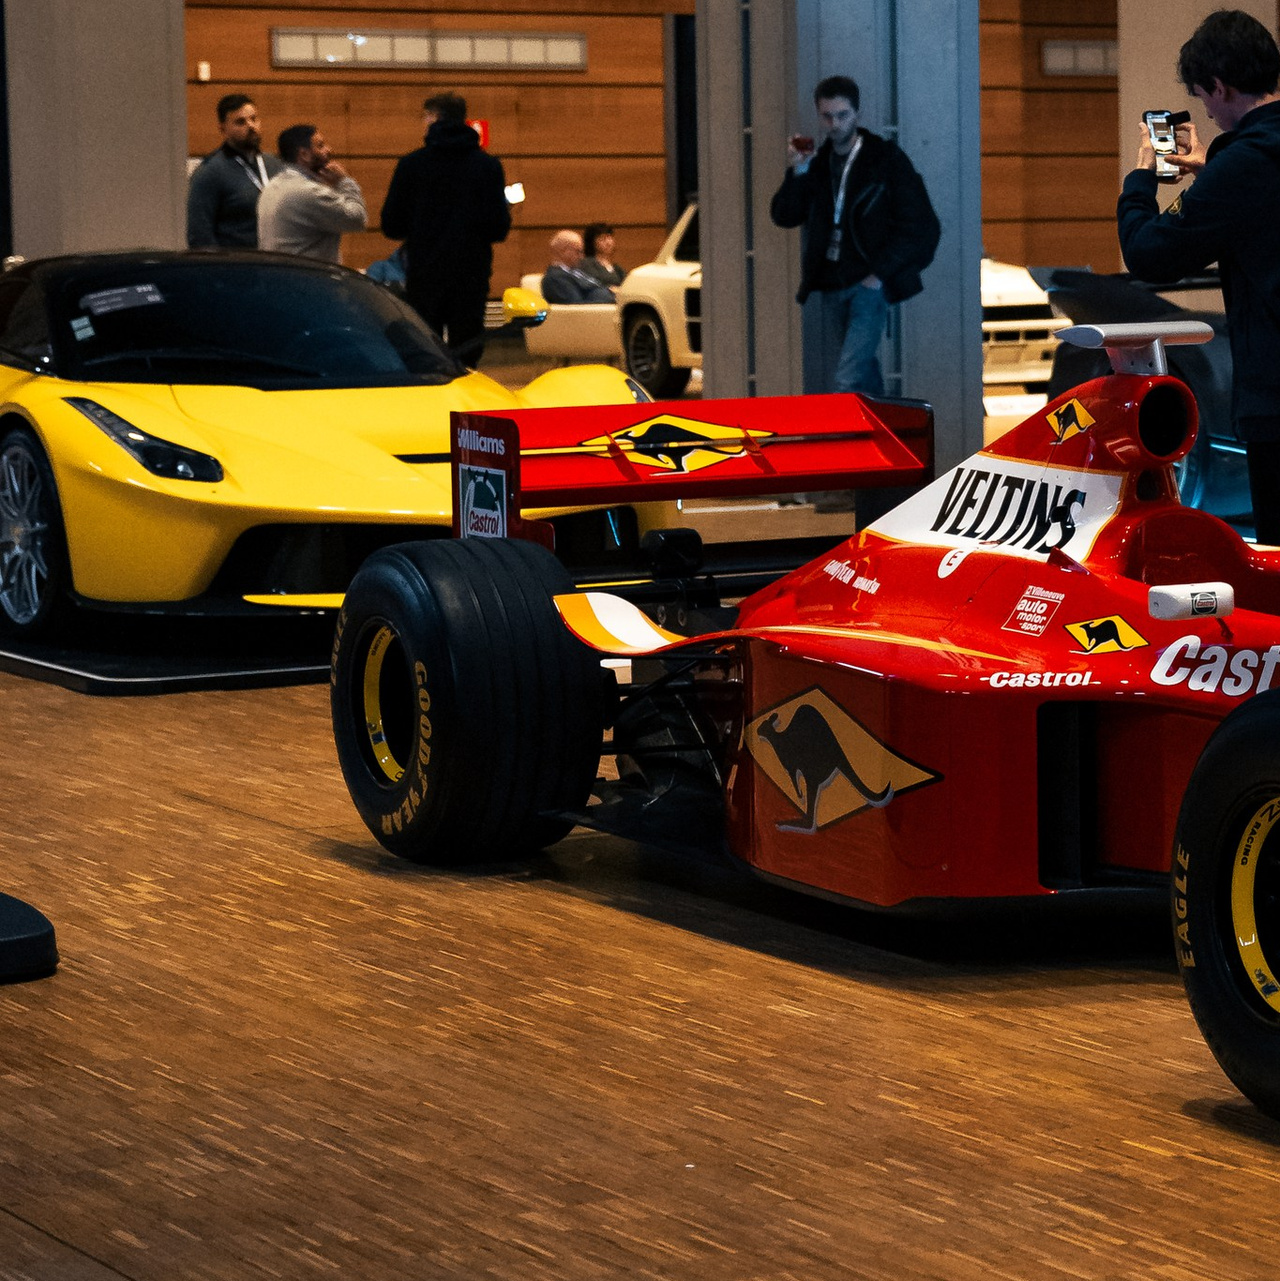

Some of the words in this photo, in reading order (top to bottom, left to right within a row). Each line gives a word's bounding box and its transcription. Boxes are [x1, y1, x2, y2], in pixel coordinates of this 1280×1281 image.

[458, 428, 505, 455] Williams
[469, 511, 499, 535] Castrol
[930, 468, 1087, 554] VELTINS
[1016, 599, 1048, 614] auto
[1016, 612, 1047, 624] motor
[989, 672, 1093, 688] Castrol
[1240, 822, 1261, 866] RACING
[1175, 843, 1196, 968] EAGLE
